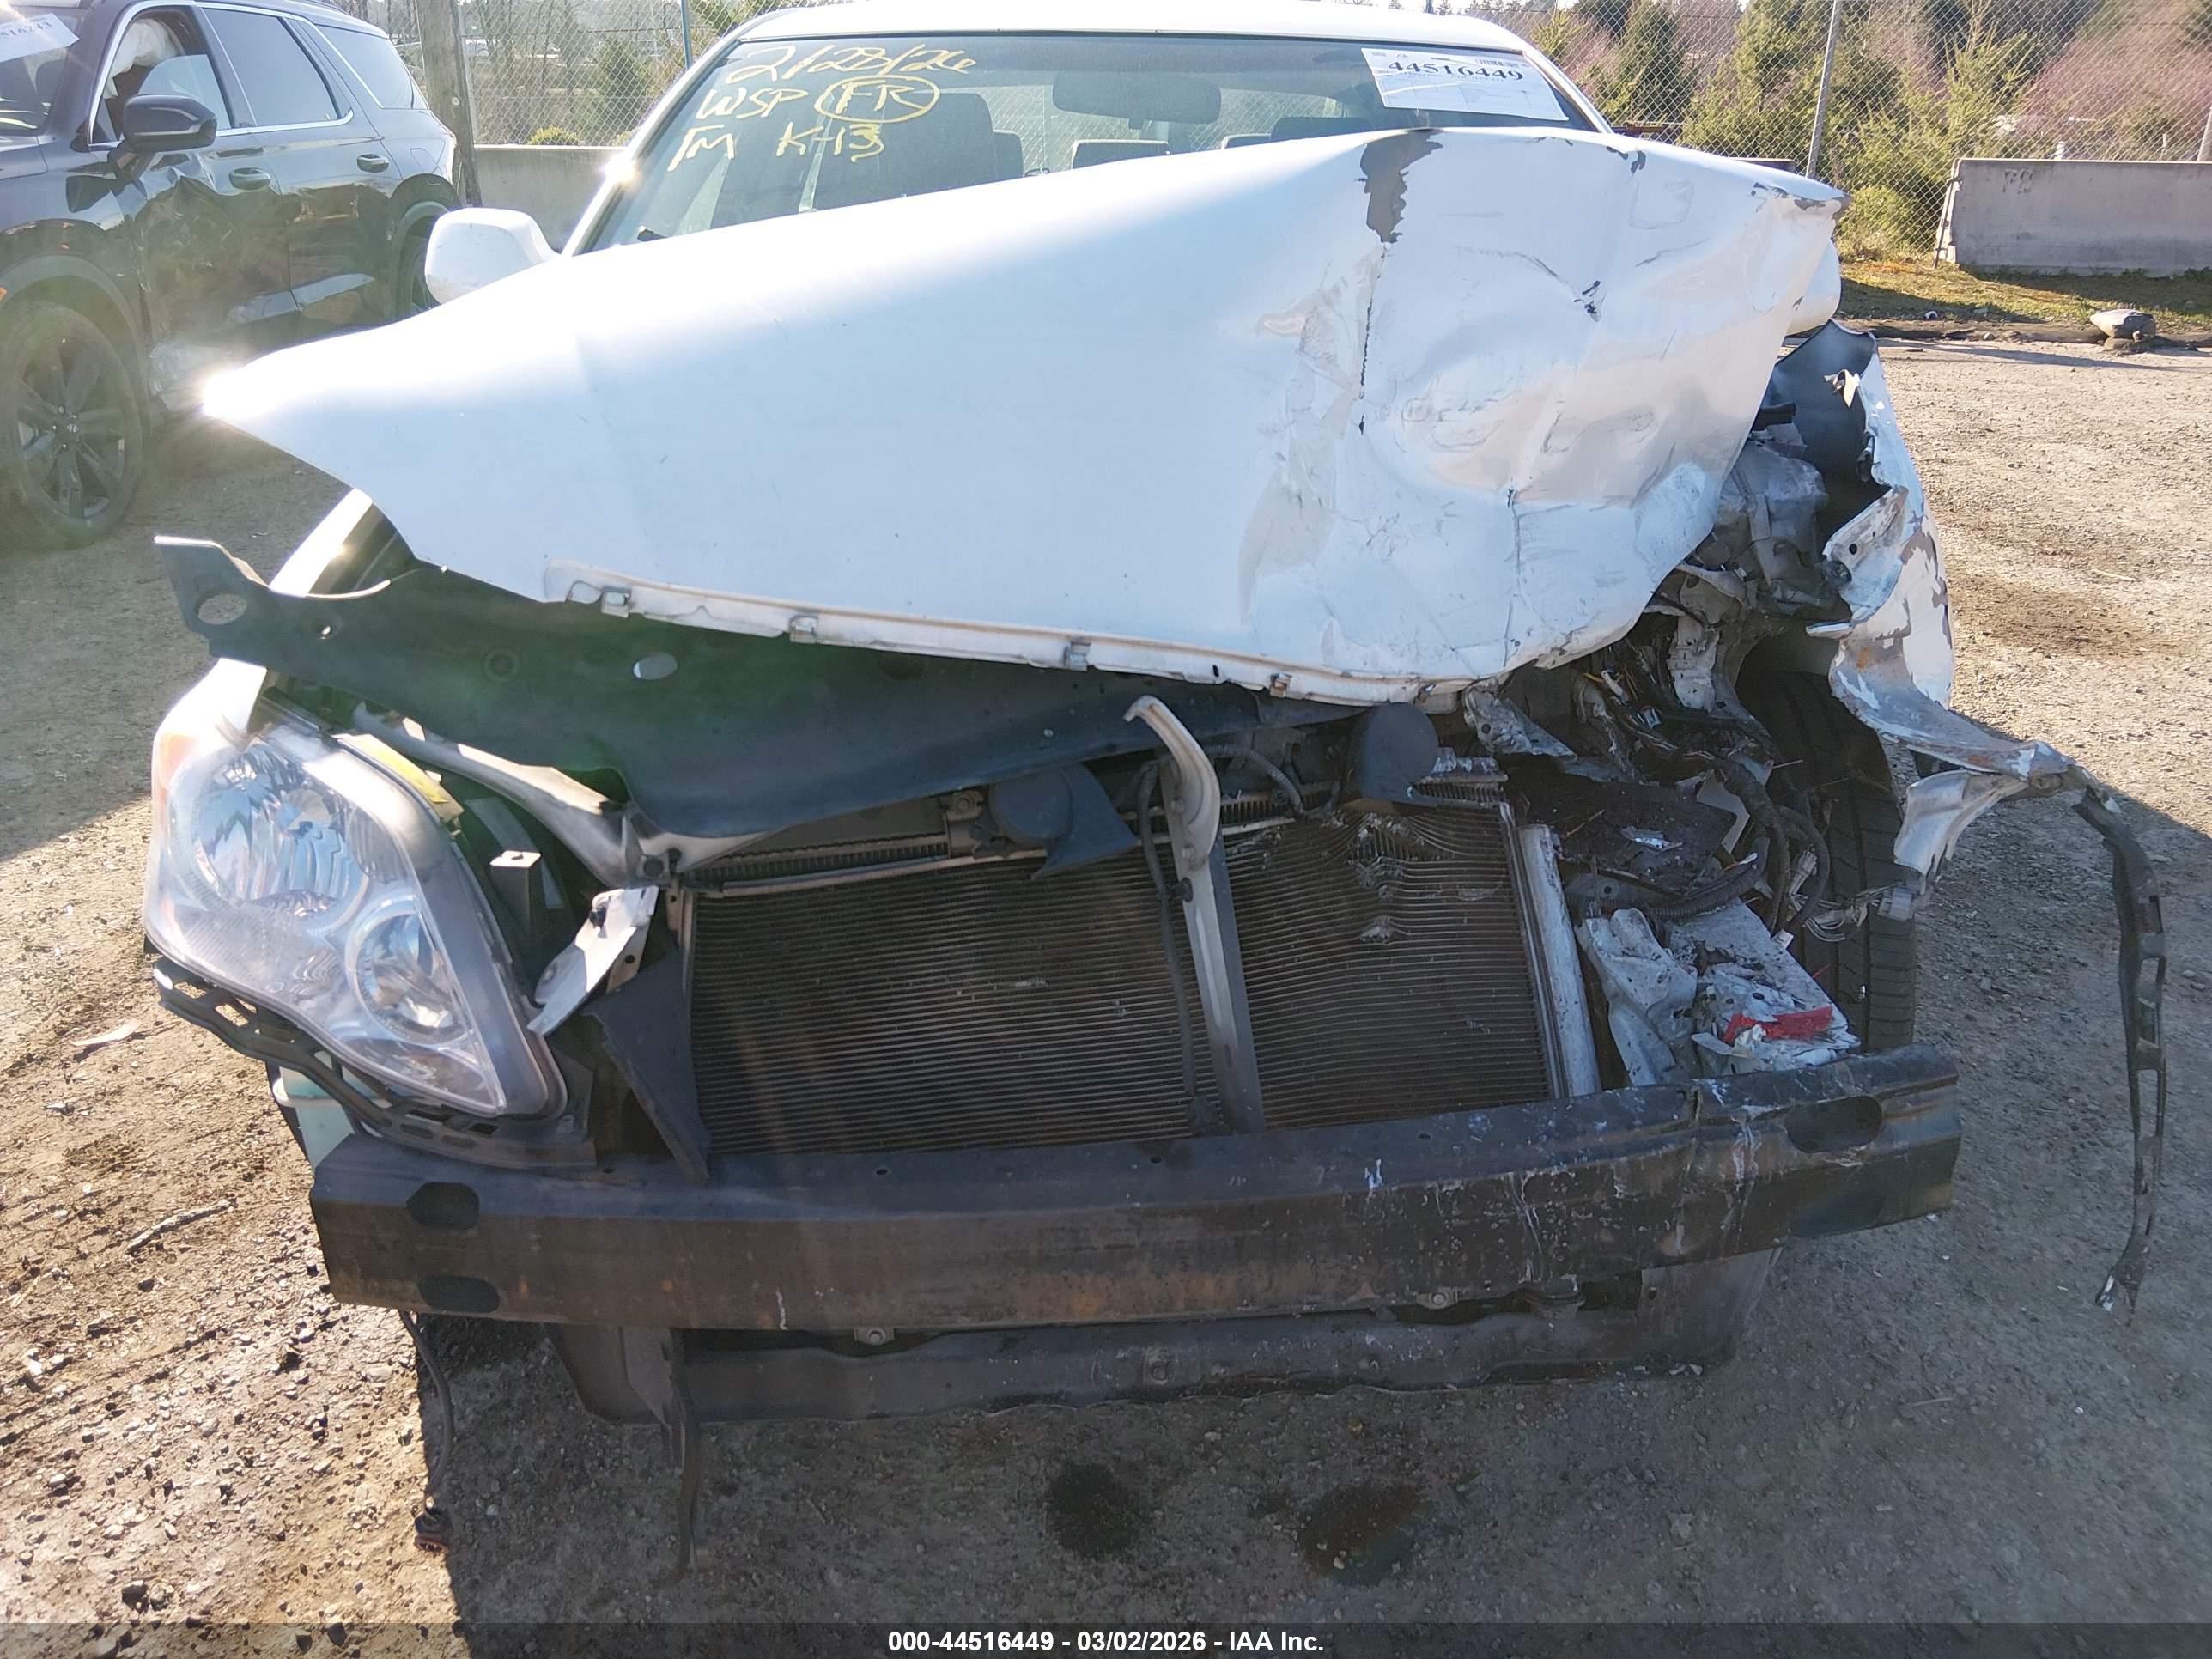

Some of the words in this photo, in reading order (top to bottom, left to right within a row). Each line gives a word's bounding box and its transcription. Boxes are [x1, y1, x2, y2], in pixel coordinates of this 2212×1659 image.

[725, 44, 976, 83] 2/28/26
[1388, 61, 1523, 81] 44516449
[696, 87, 809, 119] WSP
